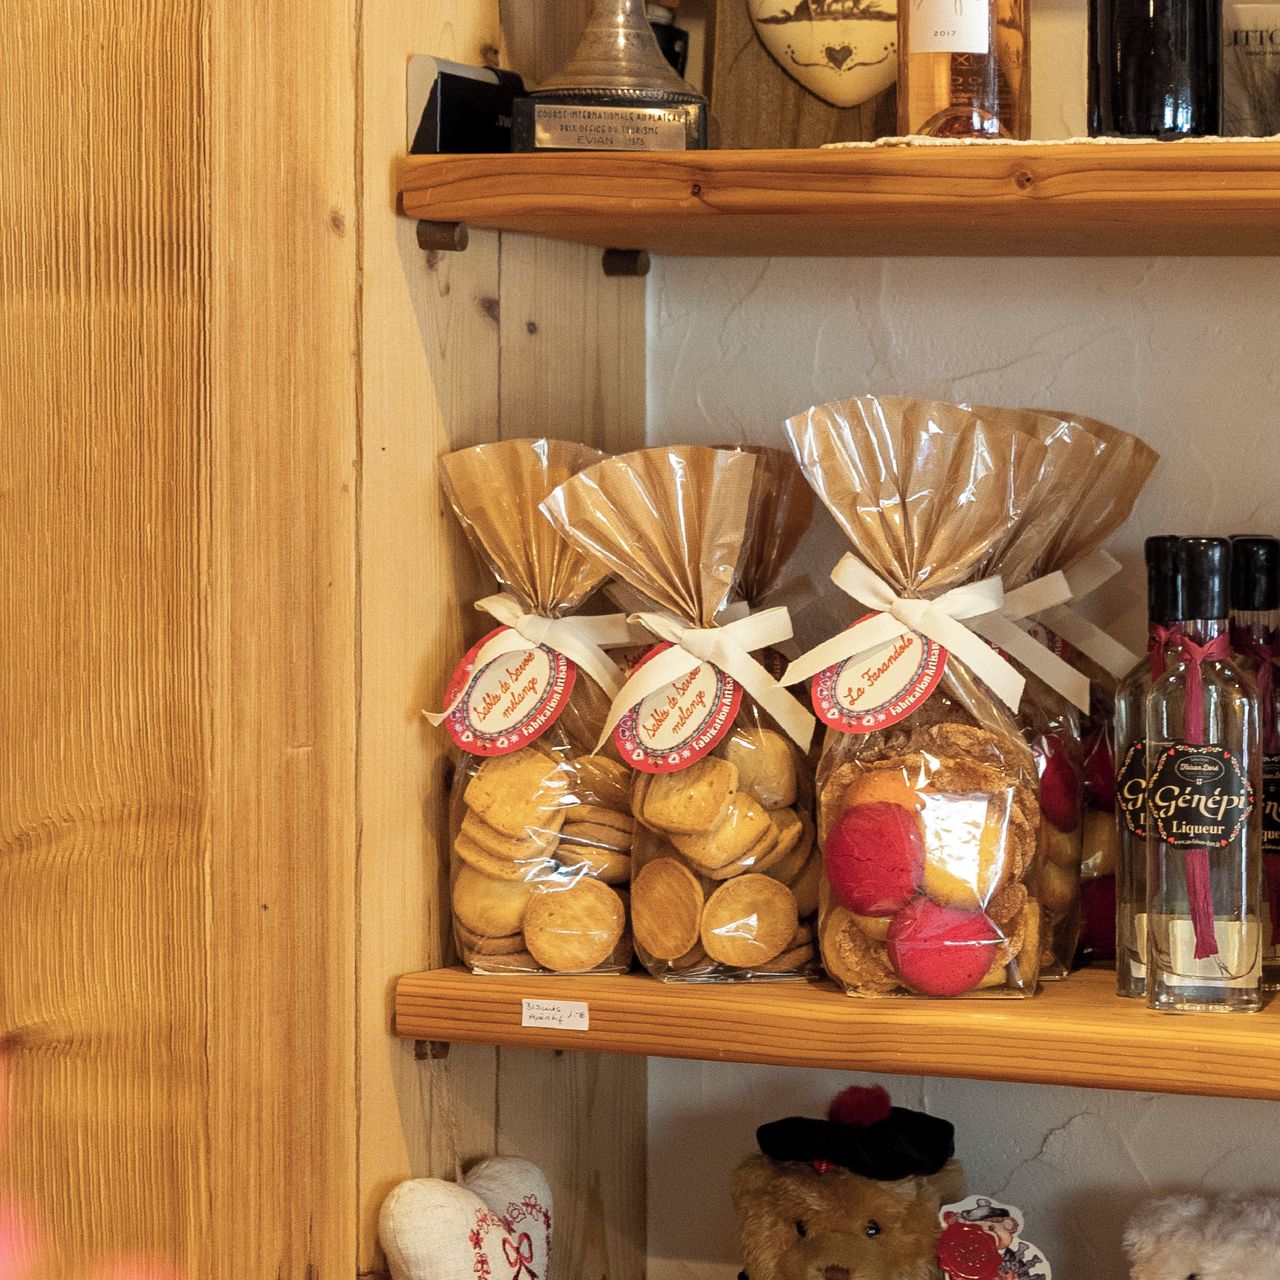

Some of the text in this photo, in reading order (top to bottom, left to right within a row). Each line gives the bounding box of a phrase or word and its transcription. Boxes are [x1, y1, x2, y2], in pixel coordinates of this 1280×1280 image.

[577, 136, 614, 144] EVIAN
[498, 680, 510, 694] de
[843, 687, 865, 706] La
[889, 676, 932, 716] Fabrication
[666, 696, 678, 709] de
[521, 694, 562, 736] Fabrication
[692, 706, 730, 750] Fabrication
[1155, 786, 1246, 820] Génépi
[1172, 821, 1226, 837] Liqueur
